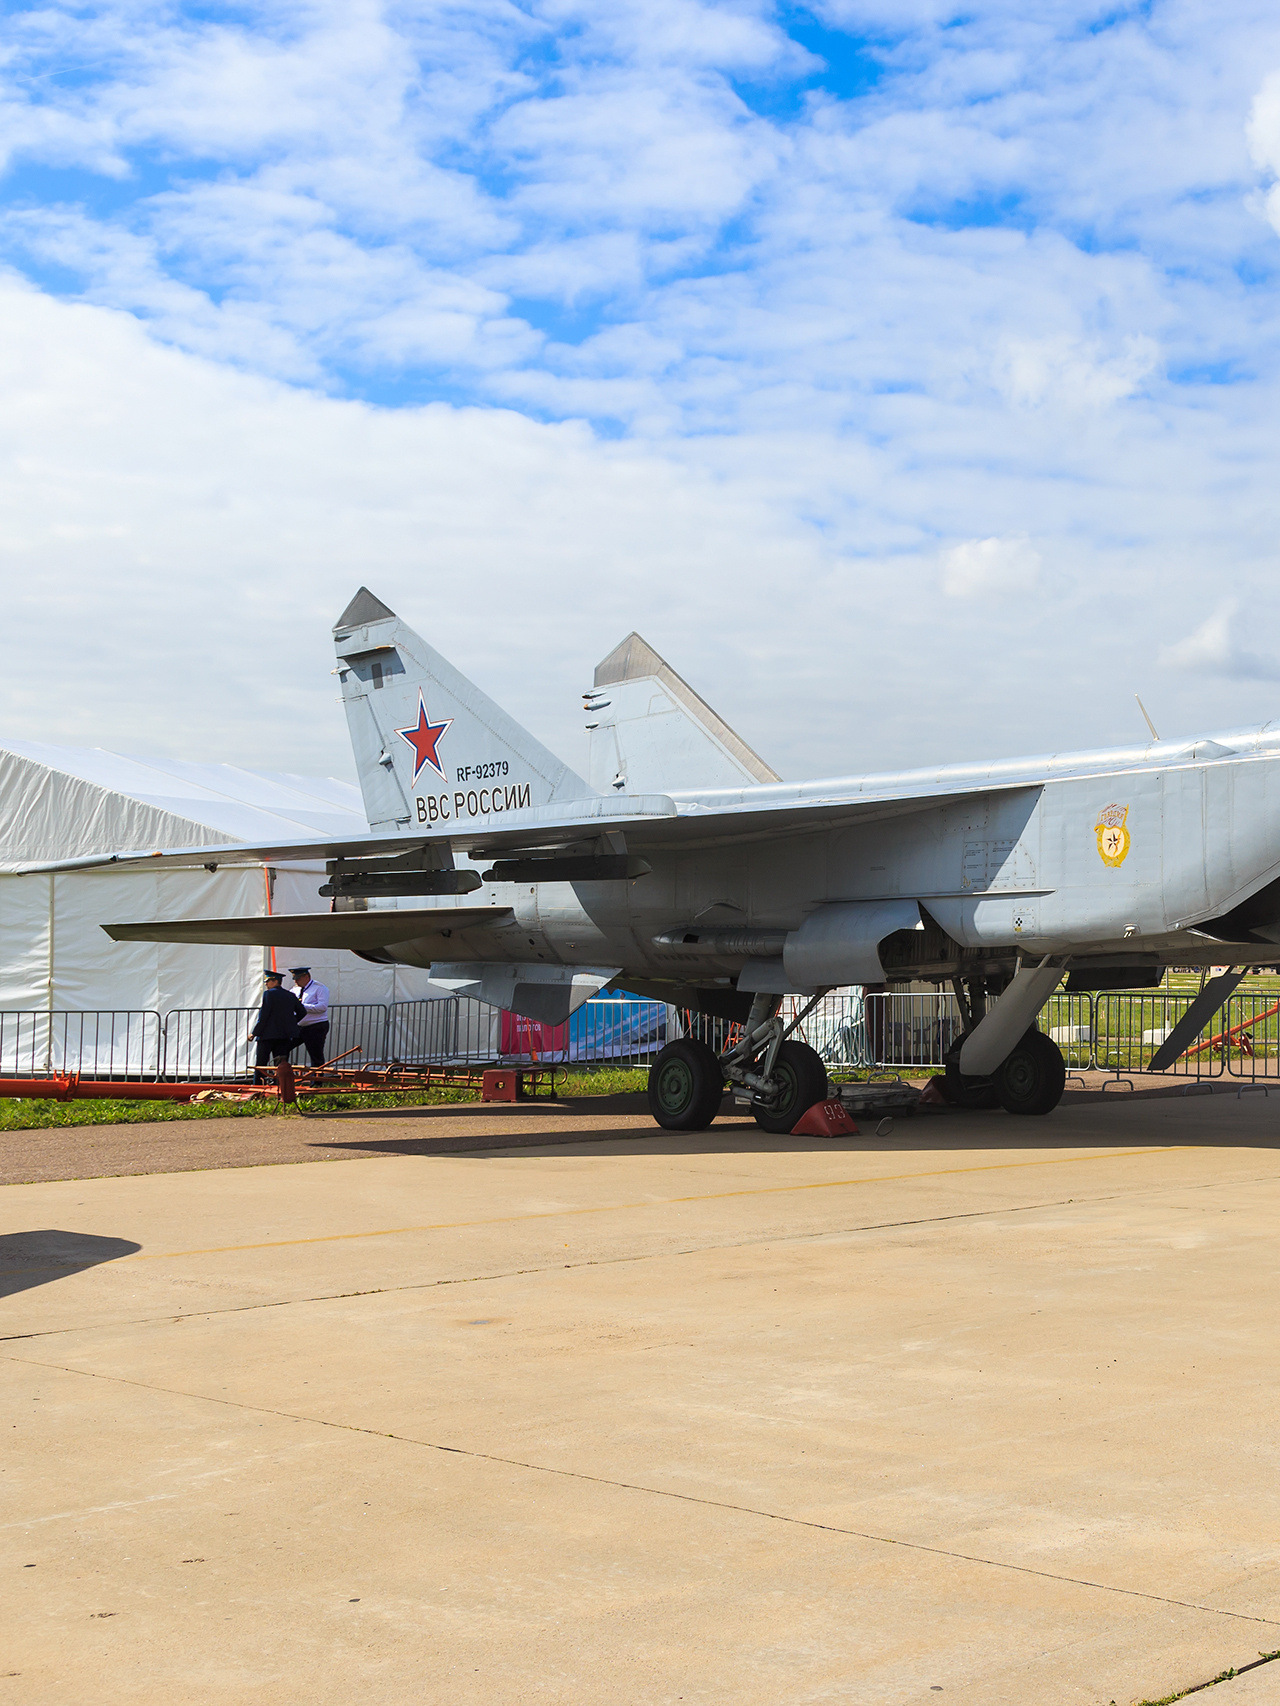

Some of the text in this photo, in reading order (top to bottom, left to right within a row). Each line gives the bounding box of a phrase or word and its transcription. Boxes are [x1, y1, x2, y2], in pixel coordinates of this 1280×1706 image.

[456, 760, 509, 782] RF-92379
[415, 783, 531, 823] ВВС РОССИИ
[823, 1103, 846, 1120] 93
